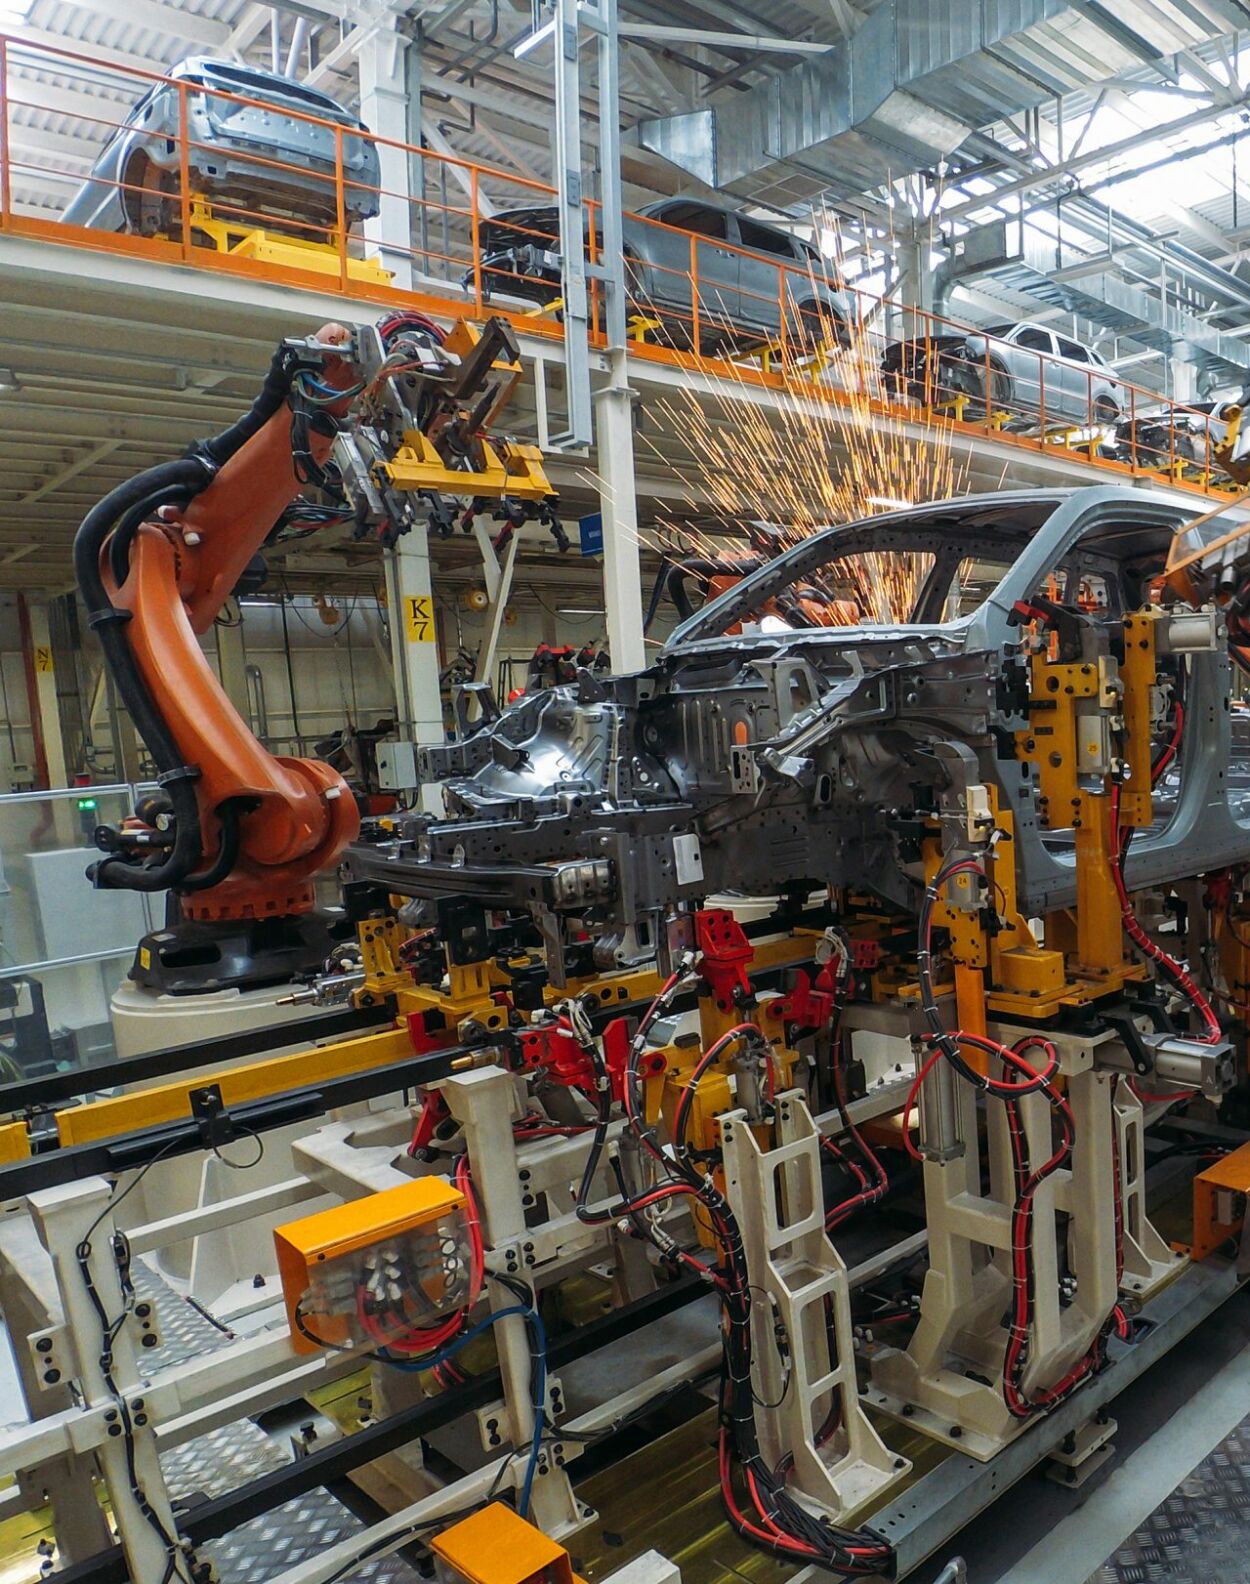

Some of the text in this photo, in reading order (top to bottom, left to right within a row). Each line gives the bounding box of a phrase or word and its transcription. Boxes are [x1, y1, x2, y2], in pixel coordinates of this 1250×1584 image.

[410, 599, 431, 619] K
[413, 621, 429, 641] 7
[38, 648, 49, 660] N
[39, 660, 48, 671] 7
